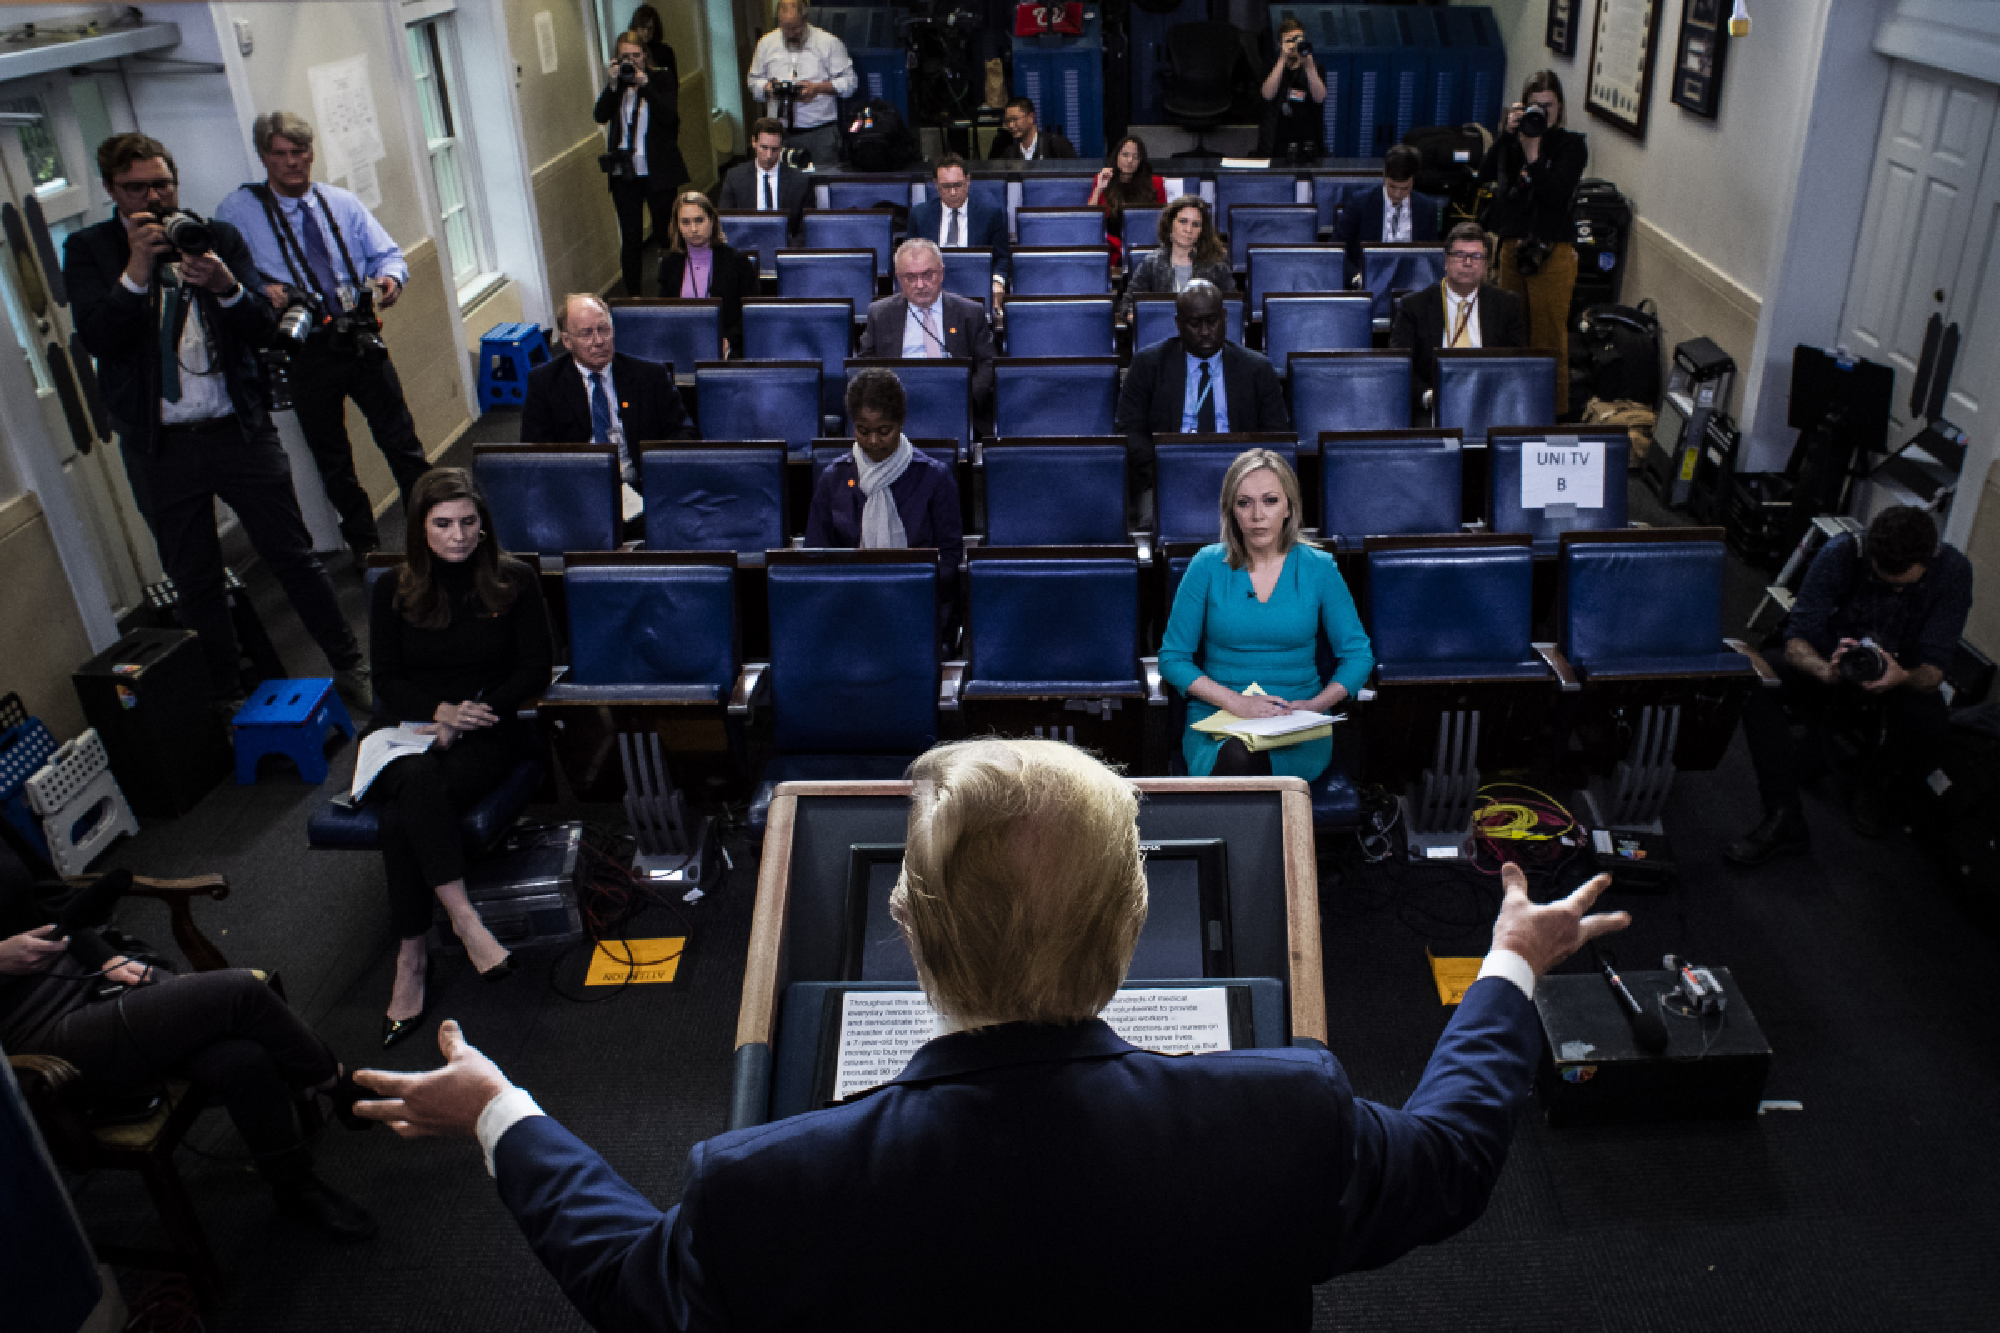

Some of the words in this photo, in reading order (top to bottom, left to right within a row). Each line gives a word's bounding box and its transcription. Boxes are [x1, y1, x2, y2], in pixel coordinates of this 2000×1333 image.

[1537, 452, 1565, 466] UNI
[1570, 452, 1590, 466] TV
[1557, 477, 1567, 492] B
[603, 971, 666, 981] ATTENION
[849, 999, 893, 1008] Throughout
[847, 1009, 883, 1018] everyday
[1169, 1005, 1198, 1013] provide
[885, 1028, 894, 1036] of
[894, 1038, 909, 1046] boy
